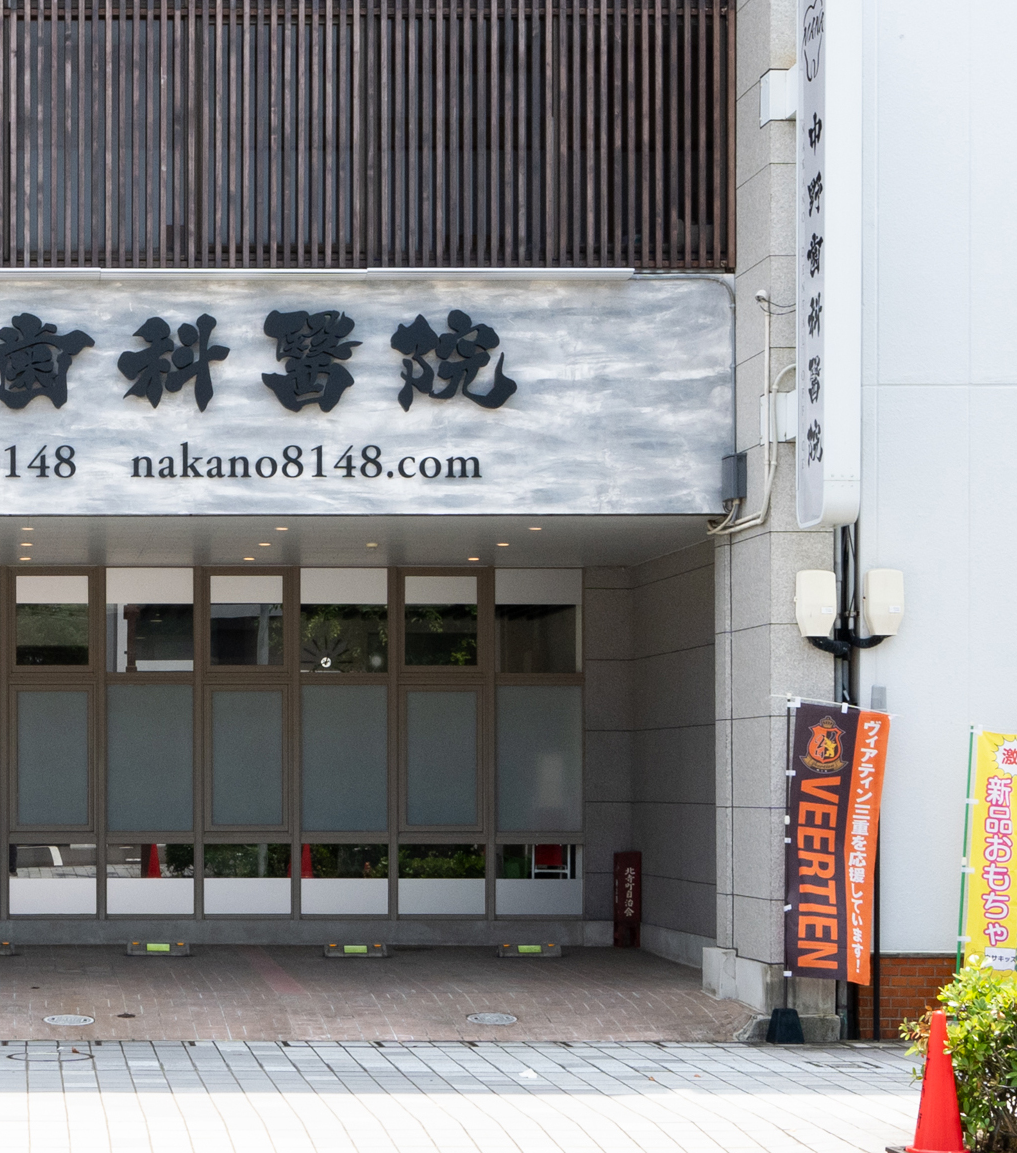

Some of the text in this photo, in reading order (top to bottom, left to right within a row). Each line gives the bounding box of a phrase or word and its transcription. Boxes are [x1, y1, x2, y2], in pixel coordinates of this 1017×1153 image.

[131, 442, 483, 479] nakano8148.com
[797, 776, 841, 969] VEERTIEN
[982, 775, 1012, 947] 新品おもちゃ
